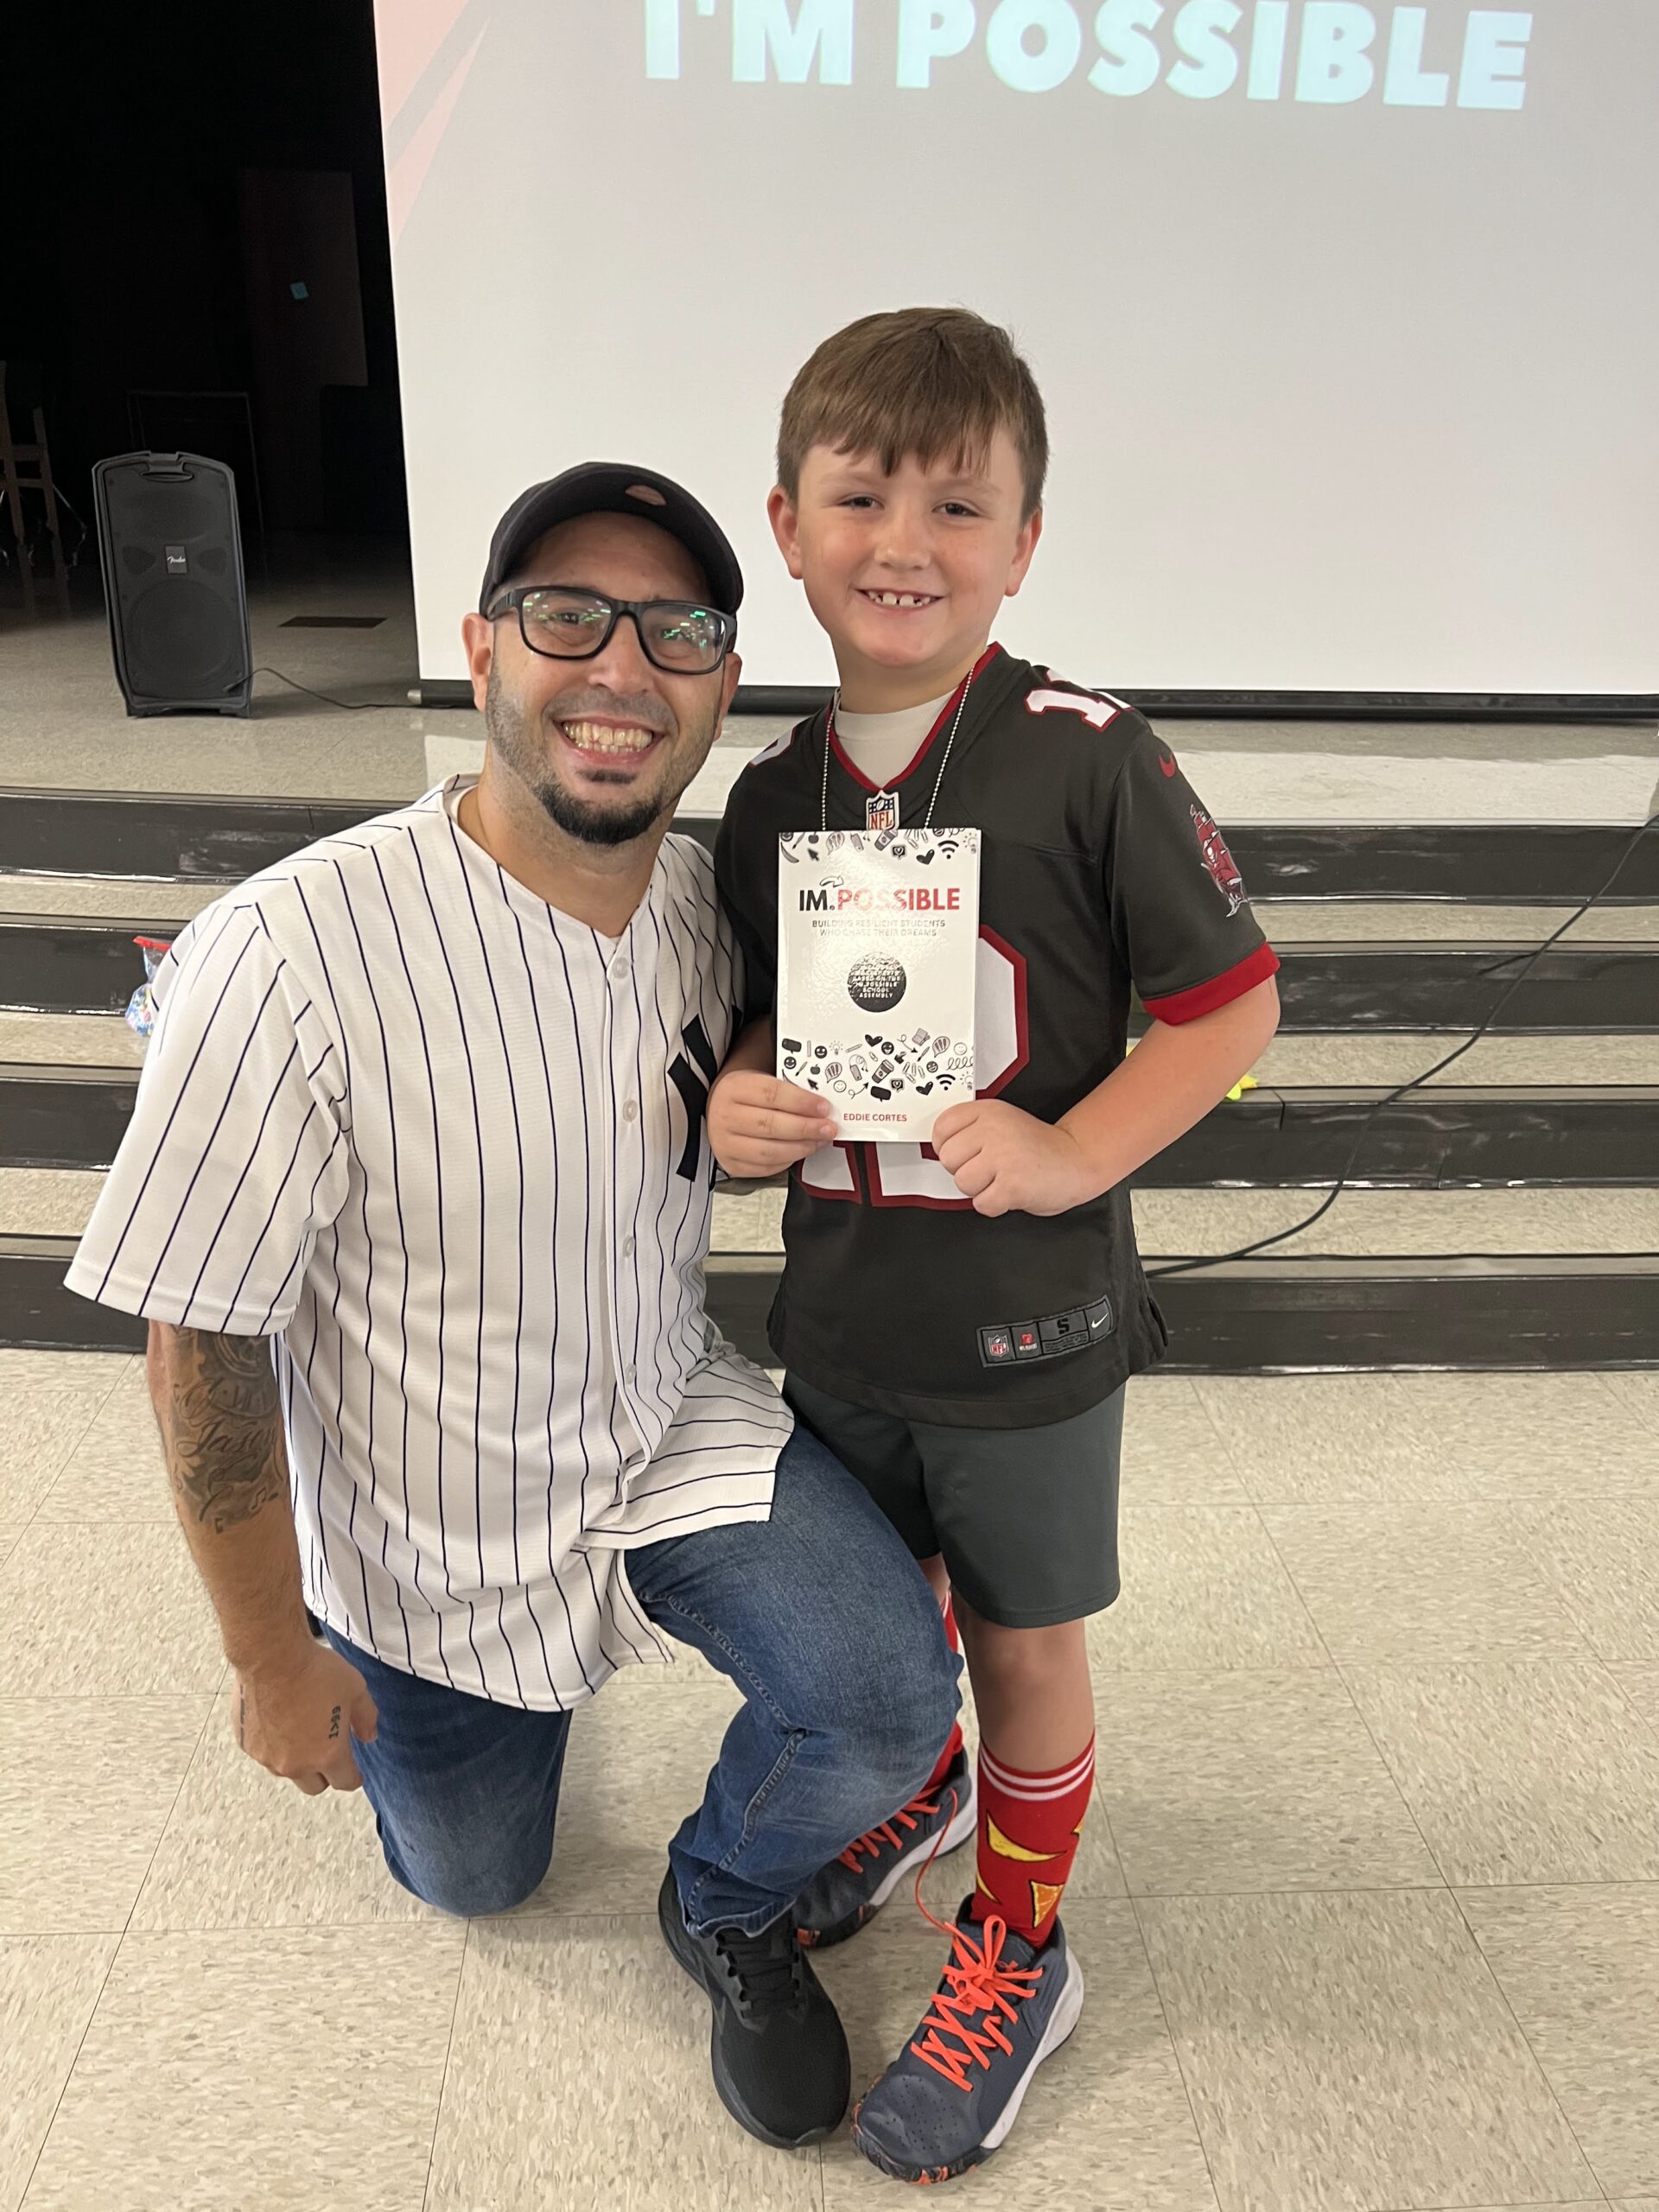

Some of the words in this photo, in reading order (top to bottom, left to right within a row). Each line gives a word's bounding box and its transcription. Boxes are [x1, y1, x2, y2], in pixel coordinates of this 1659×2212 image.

[896, 0, 1534, 111] POSSIBLE
[870, 810, 894, 830] NFL
[811, 919, 854, 928] BUILDING
[855, 919, 898, 928] RESILIENT
[820, 928, 842, 937] WHO
[842, 928, 871, 937] CHASE
[874, 928, 899, 937] THEIR
[900, 928, 938, 937] DREAMS
[1057, 1318, 1071, 1335] S
